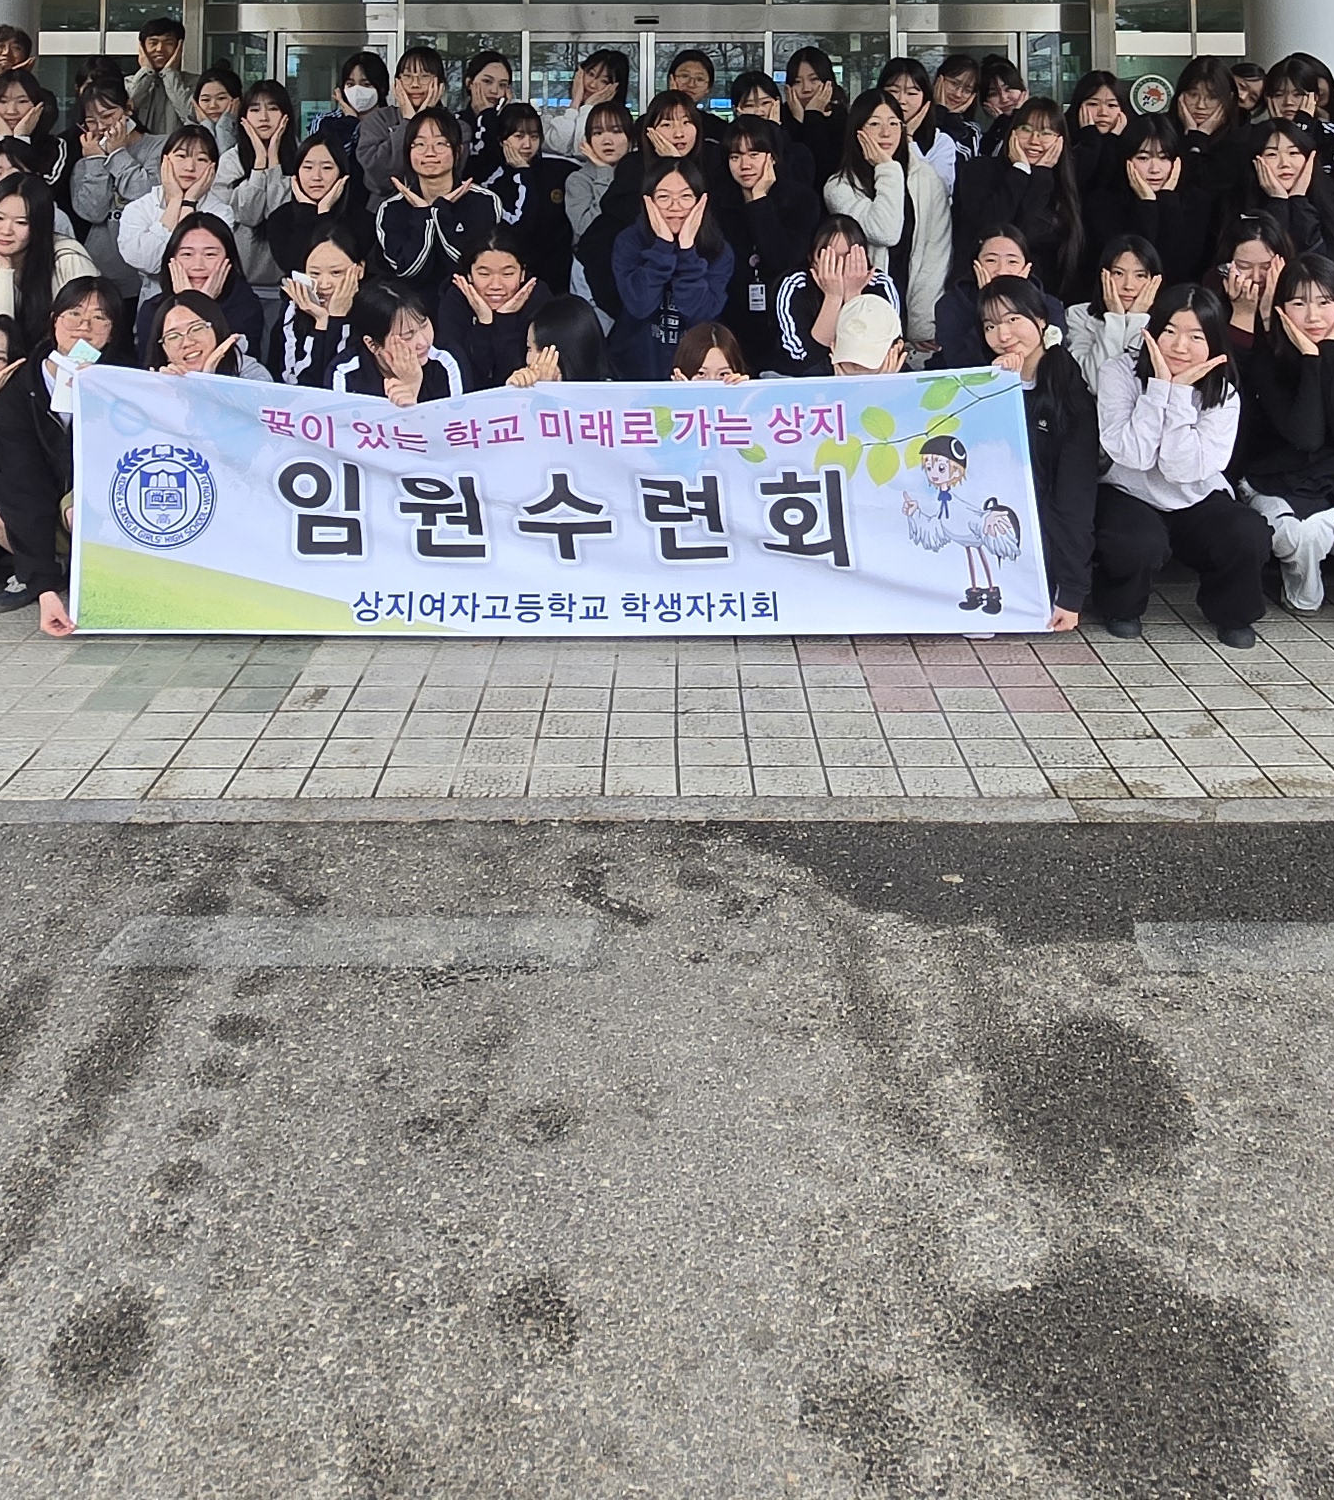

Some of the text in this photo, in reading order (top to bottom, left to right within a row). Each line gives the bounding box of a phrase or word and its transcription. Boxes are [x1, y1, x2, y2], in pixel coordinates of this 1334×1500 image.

[261, 401, 847, 454] 꿈이 있는 학교 미래로 가는 상지
[117, 505, 139, 534] SANGJI
[164, 532, 185, 544] HIGH
[352, 590, 780, 624] 상지여자고등학교 학생자치회
